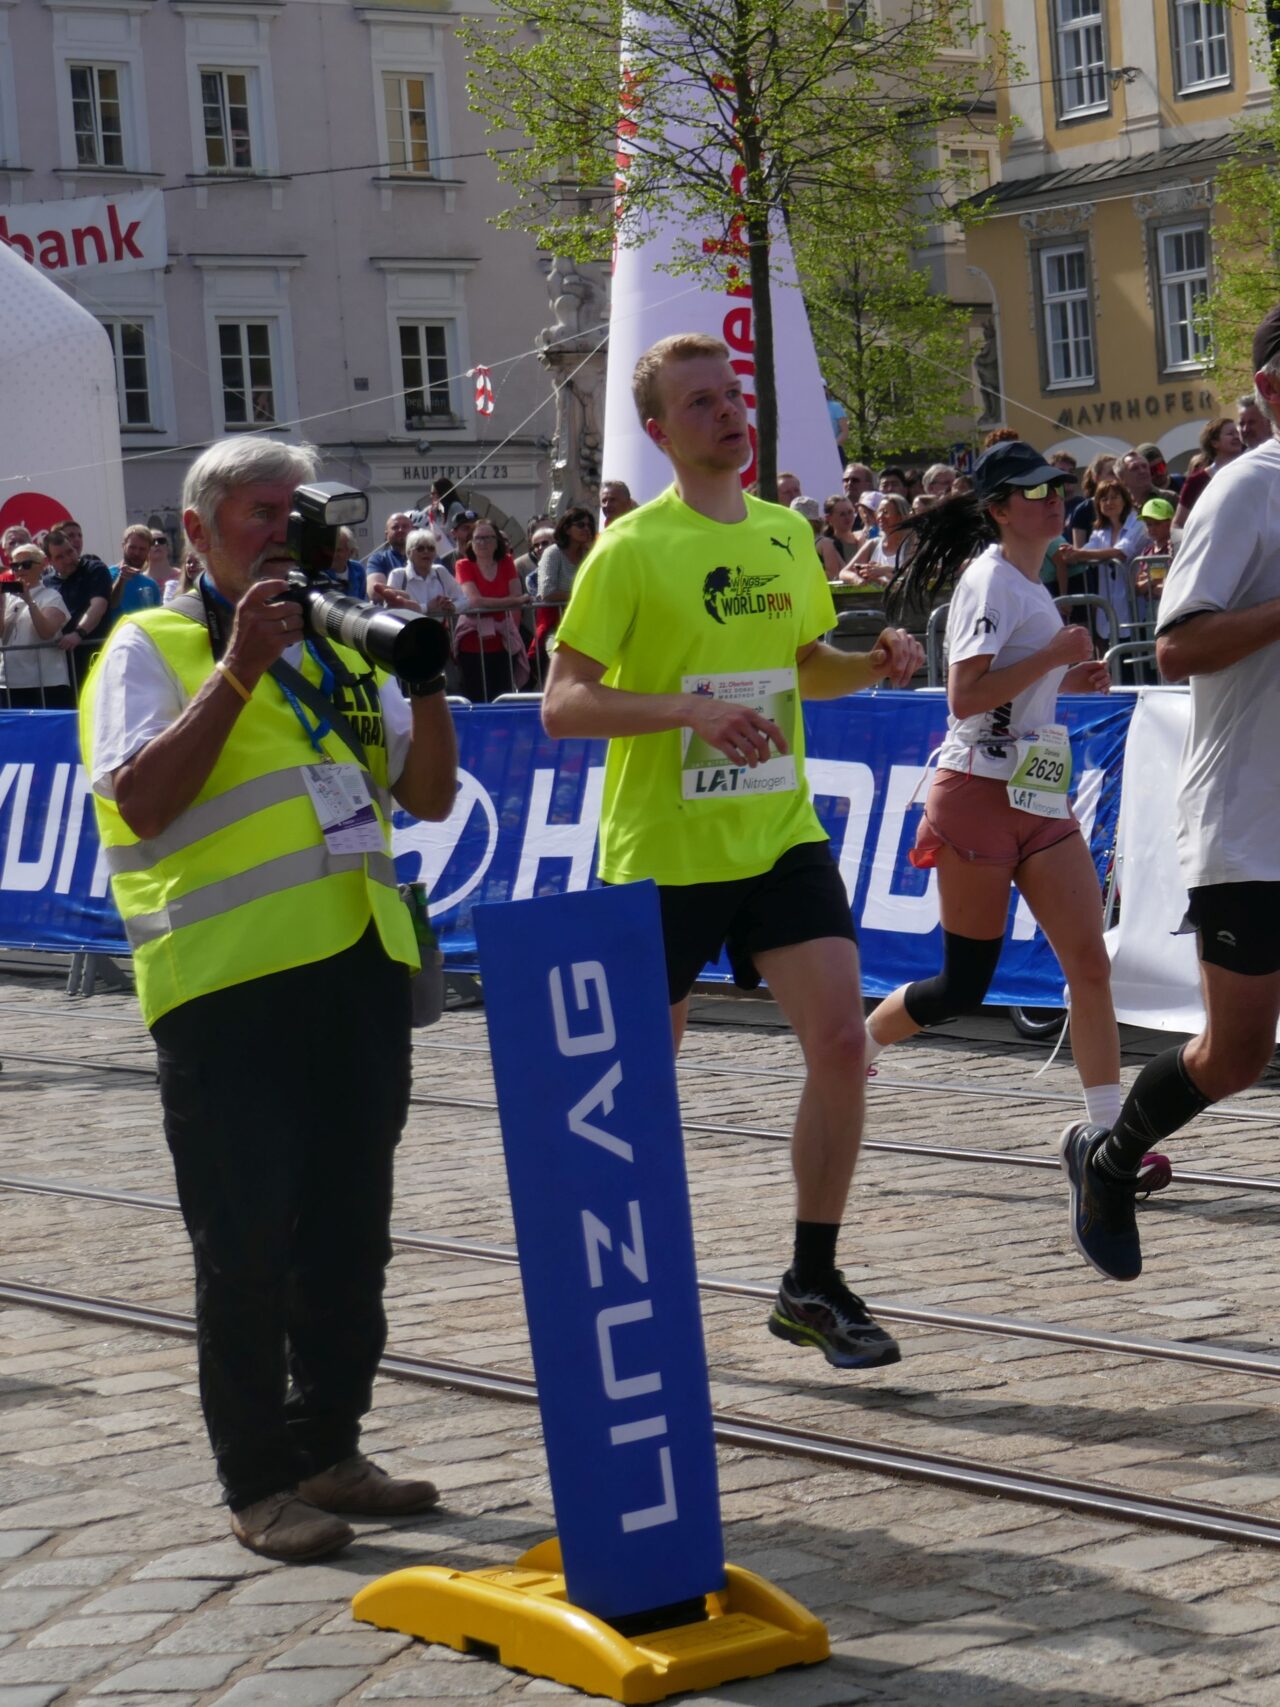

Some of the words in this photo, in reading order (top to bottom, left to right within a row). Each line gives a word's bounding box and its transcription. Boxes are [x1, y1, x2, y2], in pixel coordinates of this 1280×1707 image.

[1052, 390, 1213, 431] MAYRHOFER
[403, 465, 488, 481] HAUPTPLATZ
[493, 464, 509, 479] 23
[720, 594, 767, 617] WORLD
[766, 592, 793, 613] RUN
[695, 768, 747, 793] LAT
[742, 776, 786, 790] Nitrogen
[1025, 757, 1064, 783] 2629
[548, 960, 635, 1164] AG
[581, 1199, 678, 1533] LINZ
